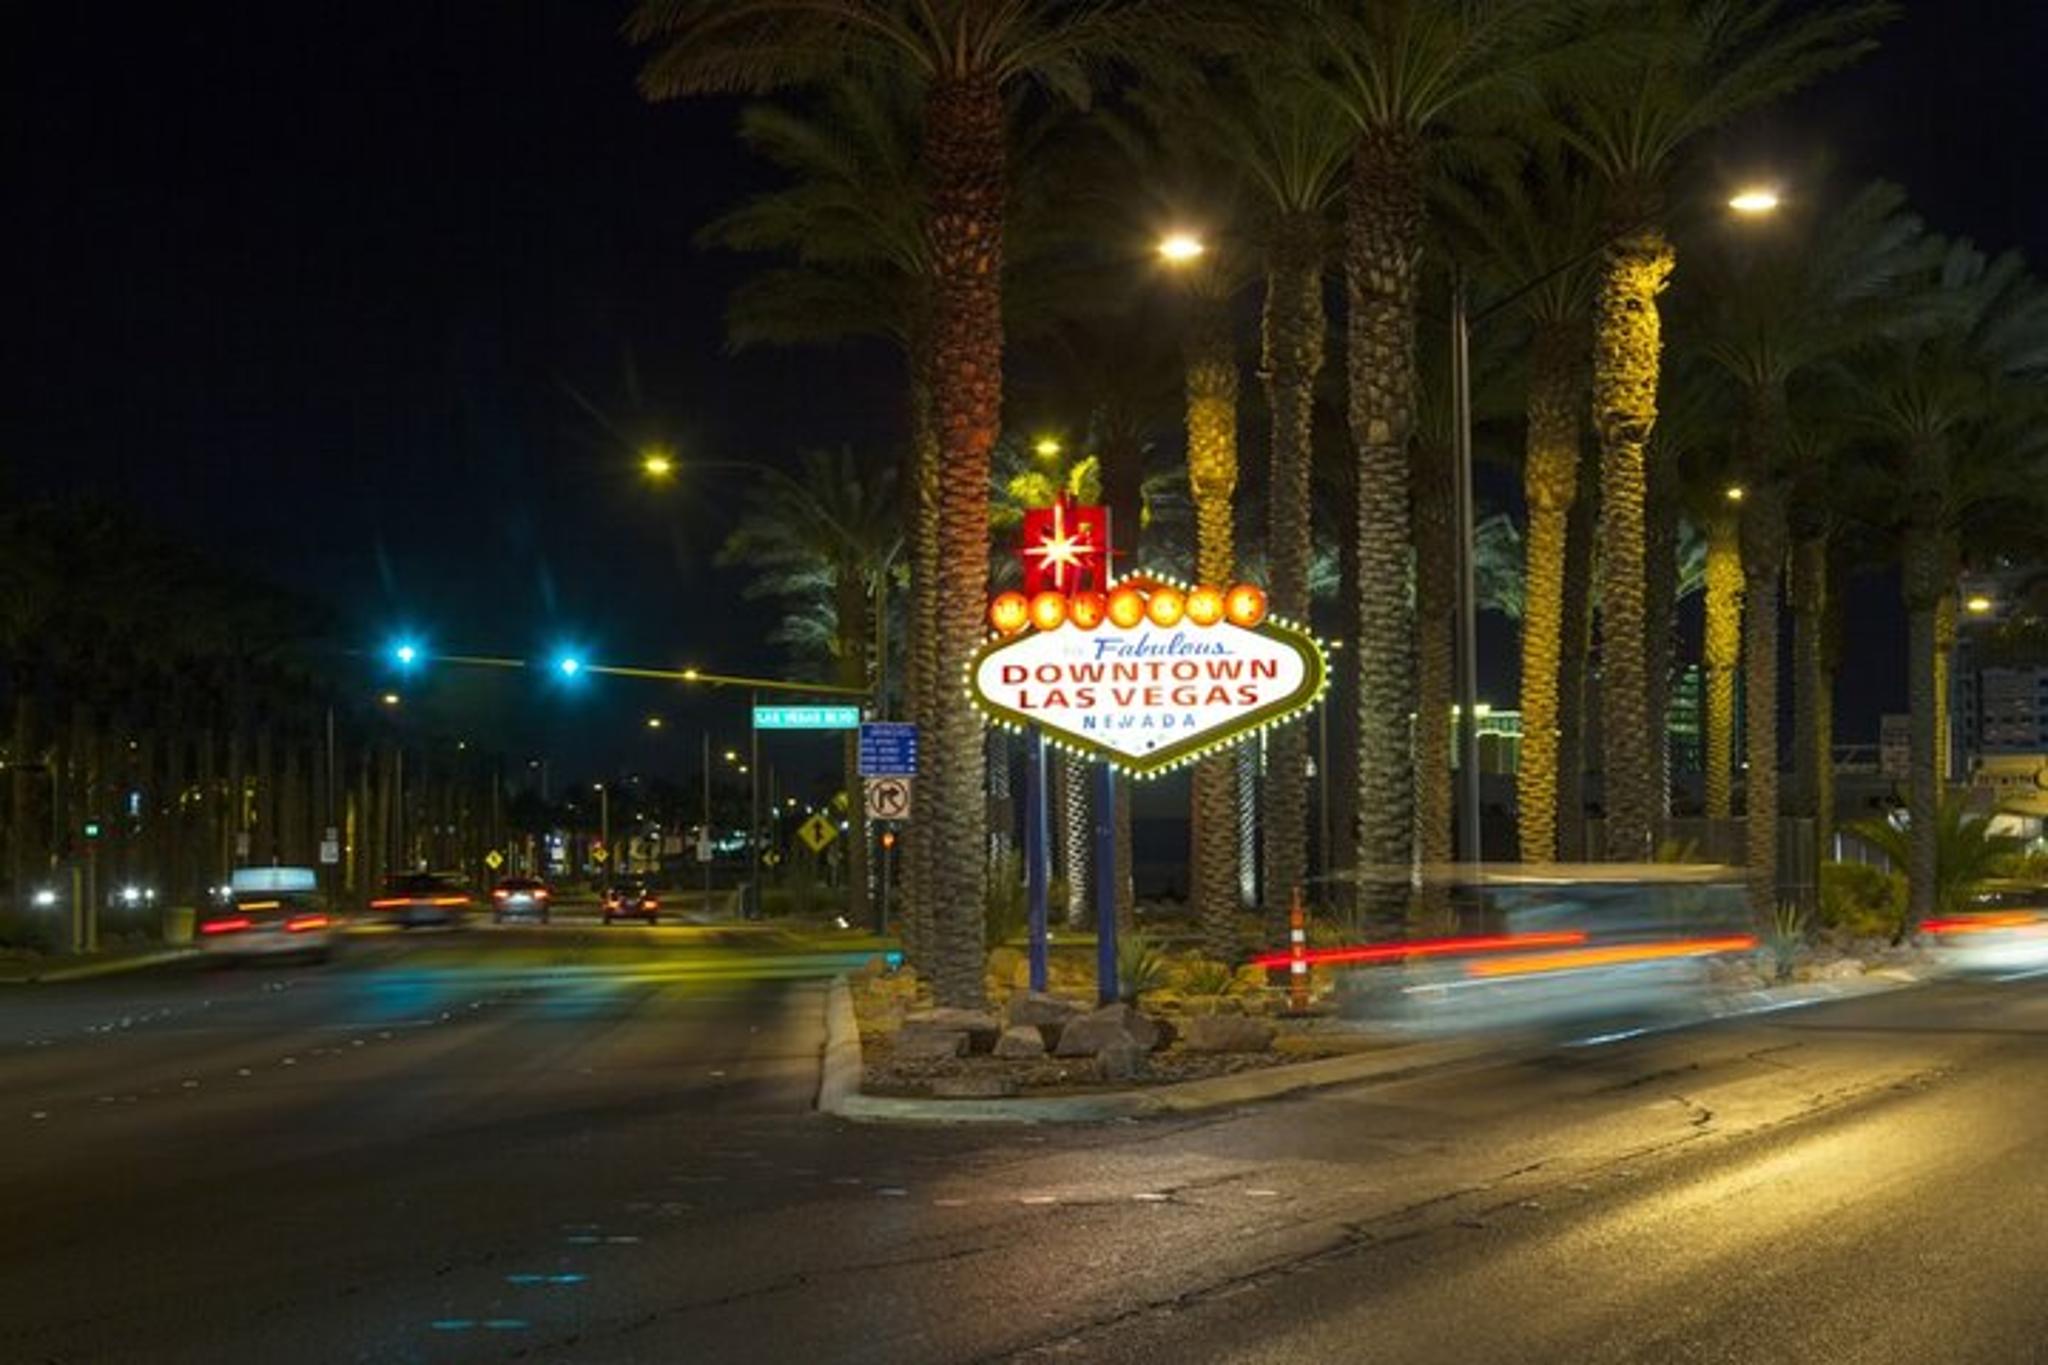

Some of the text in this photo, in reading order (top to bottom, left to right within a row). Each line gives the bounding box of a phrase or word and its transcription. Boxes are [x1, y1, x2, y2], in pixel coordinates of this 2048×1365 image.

[1093, 632, 1237, 660] Fabulous
[1002, 658, 1279, 684] DOWNTOWN
[1018, 685, 1259, 709] LAS VEGAS
[1084, 714, 1195, 730] NEVADA
